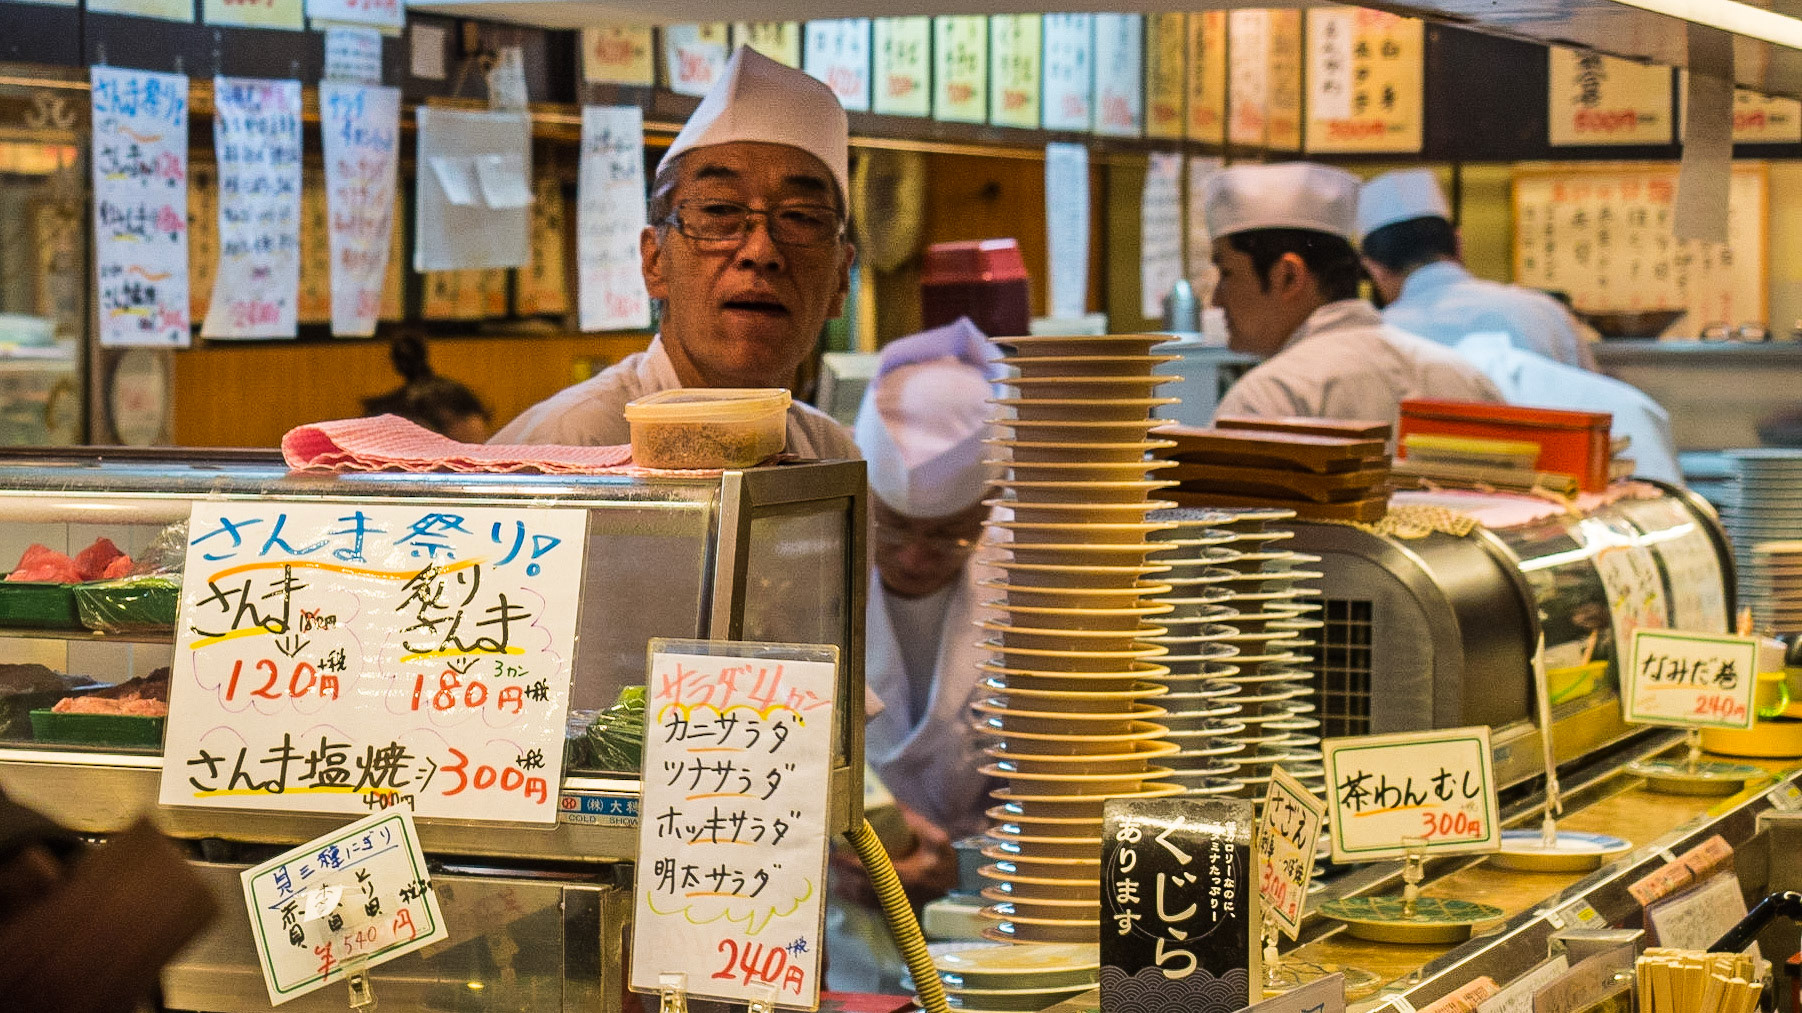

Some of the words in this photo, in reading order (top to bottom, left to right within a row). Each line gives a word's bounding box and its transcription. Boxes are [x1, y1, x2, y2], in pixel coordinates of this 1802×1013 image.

[190, 511, 562, 578] さんま祭り!
[190, 565, 310, 637] さんま
[400, 593, 532, 655] さんま
[226, 659, 340, 702] 120円
[411, 670, 523, 714] 180円
[1642, 654, 1738, 690] なみだ巻
[665, 713, 804, 754] カニサラダ
[187, 732, 415, 794] さんま塩焼
[440, 747, 548, 805] 300円
[664, 758, 796, 801] ツナサラダ
[1339, 767, 1480, 812] 茶わんむし
[568, 813, 597, 824] COLD
[656, 806, 801, 846] ホッキサラダ
[1420, 811, 1481, 839] 300円
[654, 858, 782, 898] 明太サラダ
[1113, 820, 1143, 937] あります
[1155, 815, 1198, 980] くじら
[711, 938, 805, 996] 240円
